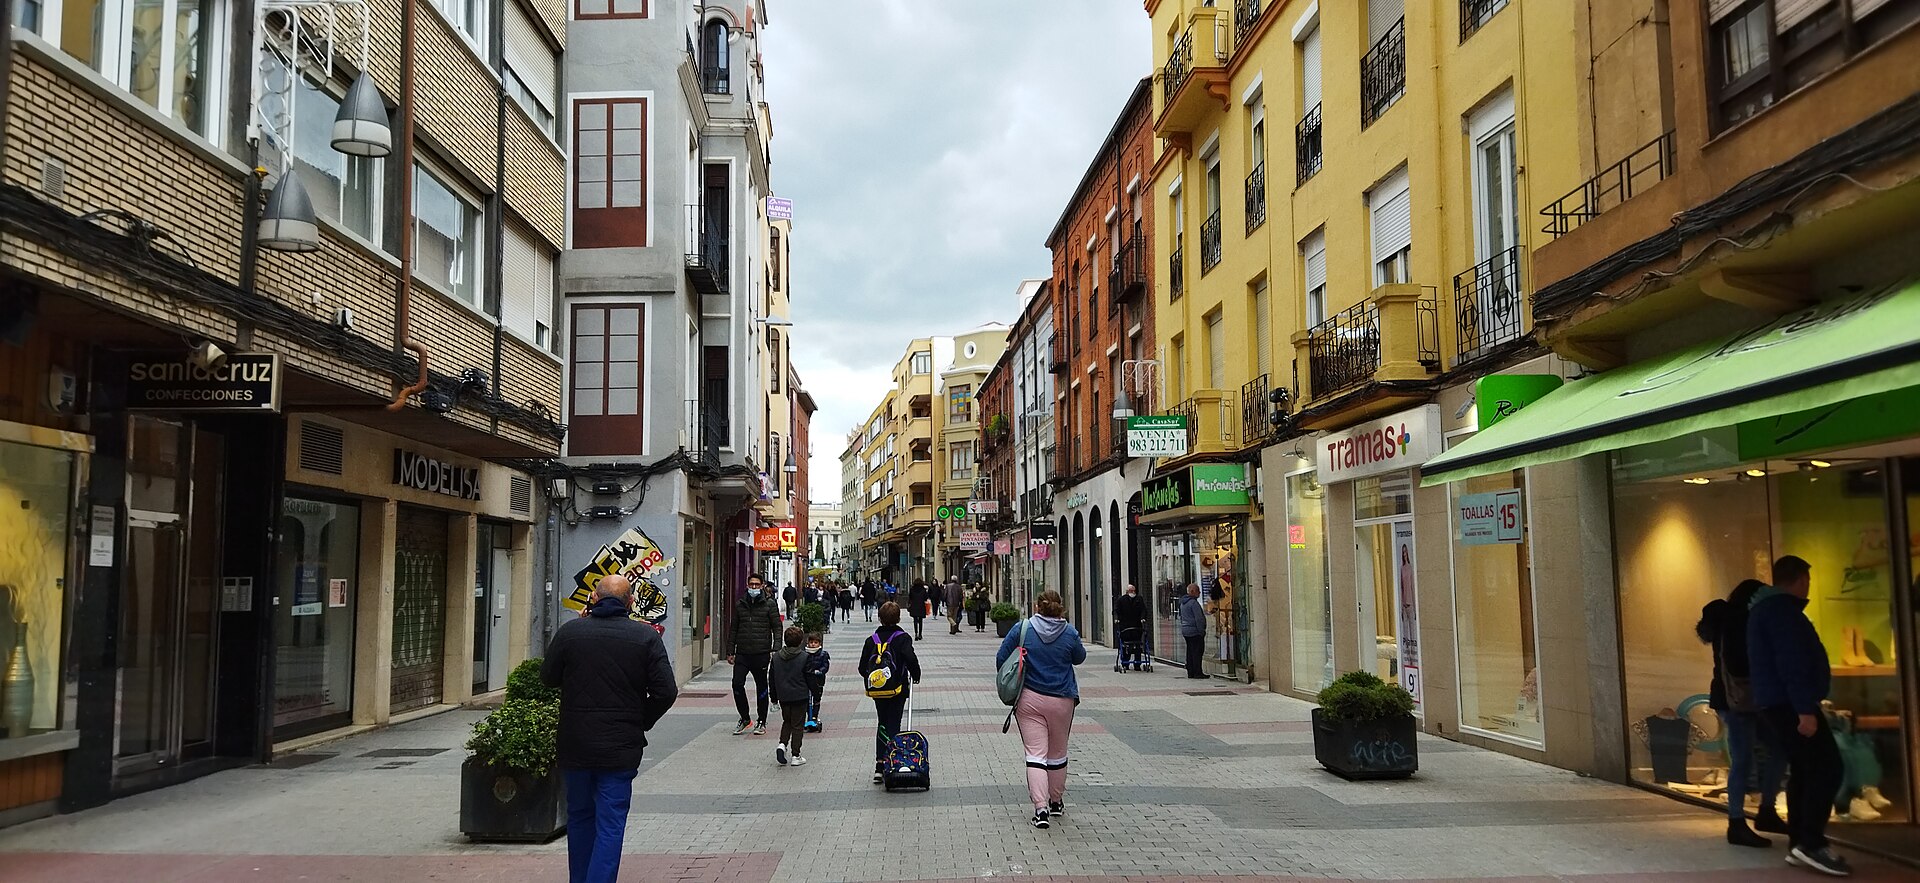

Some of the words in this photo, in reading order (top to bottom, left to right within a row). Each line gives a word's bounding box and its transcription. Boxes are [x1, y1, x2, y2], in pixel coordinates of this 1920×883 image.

[145, 389, 253, 401] CONFECCIONES
[1138, 430, 1176, 438] VENTA
[1130, 439, 1147, 451] 983
[1150, 439, 1166, 451] 212
[1169, 439, 1185, 451] 711
[399, 449, 480, 500] MODELISA
[1196, 477, 1246, 493] Marionetas
[1143, 477, 1179, 511] Marionetas
[1461, 504, 1494, 520] TOALLAS
[752, 541, 780, 549] MUÑOZ
